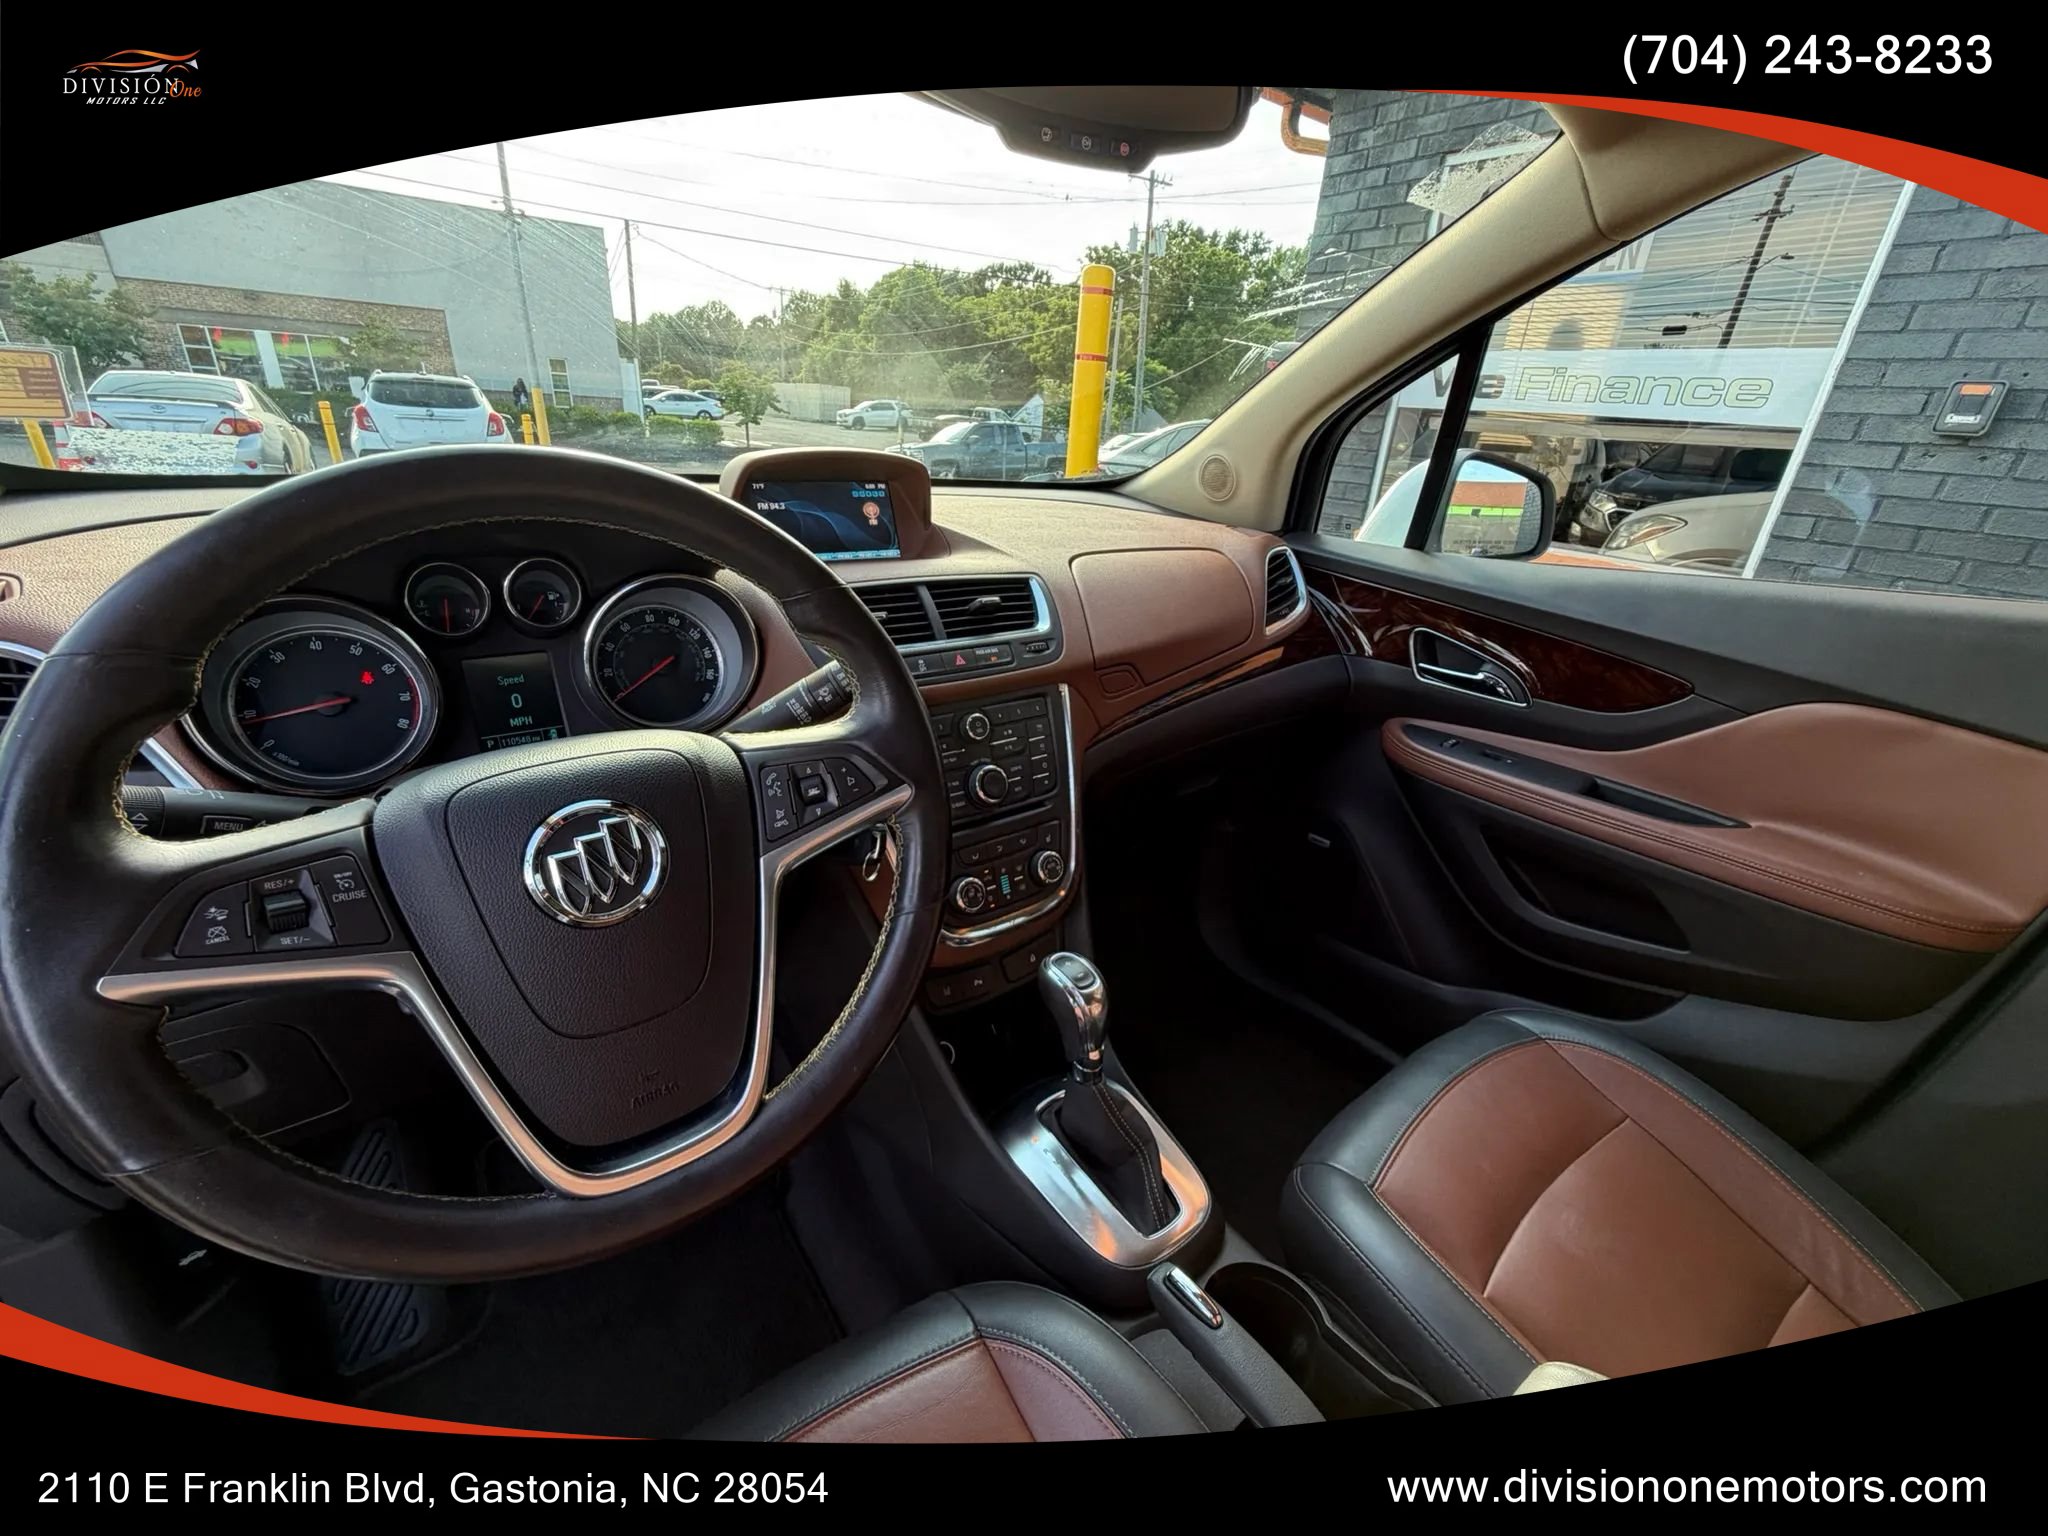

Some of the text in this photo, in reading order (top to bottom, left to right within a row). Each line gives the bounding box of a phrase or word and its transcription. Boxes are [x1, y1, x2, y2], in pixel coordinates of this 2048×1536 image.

[1515, 366, 1774, 409] Finance
[644, 613, 655, 623] 80
[667, 616, 681, 627] 100
[688, 628, 701, 641] 120
[309, 640, 323, 651] 40
[349, 644, 363, 656] 50
[268, 651, 286, 664] 30
[381, 663, 396, 675] 60
[603, 667, 614, 678] 20
[246, 676, 261, 689] 20
[496, 674, 525, 687] Speed
[398, 691, 411, 702] 70
[511, 693, 523, 708] 0
[243, 709, 257, 719] 10
[397, 717, 410, 729] 80
[509, 715, 533, 728] MPH
[263, 739, 276, 747] 0
[486, 740, 494, 749] P
[214, 821, 244, 832] MENU
[264, 879, 295, 891] RES/+
[332, 889, 368, 903] CRUISE
[205, 935, 231, 945] CANCEL
